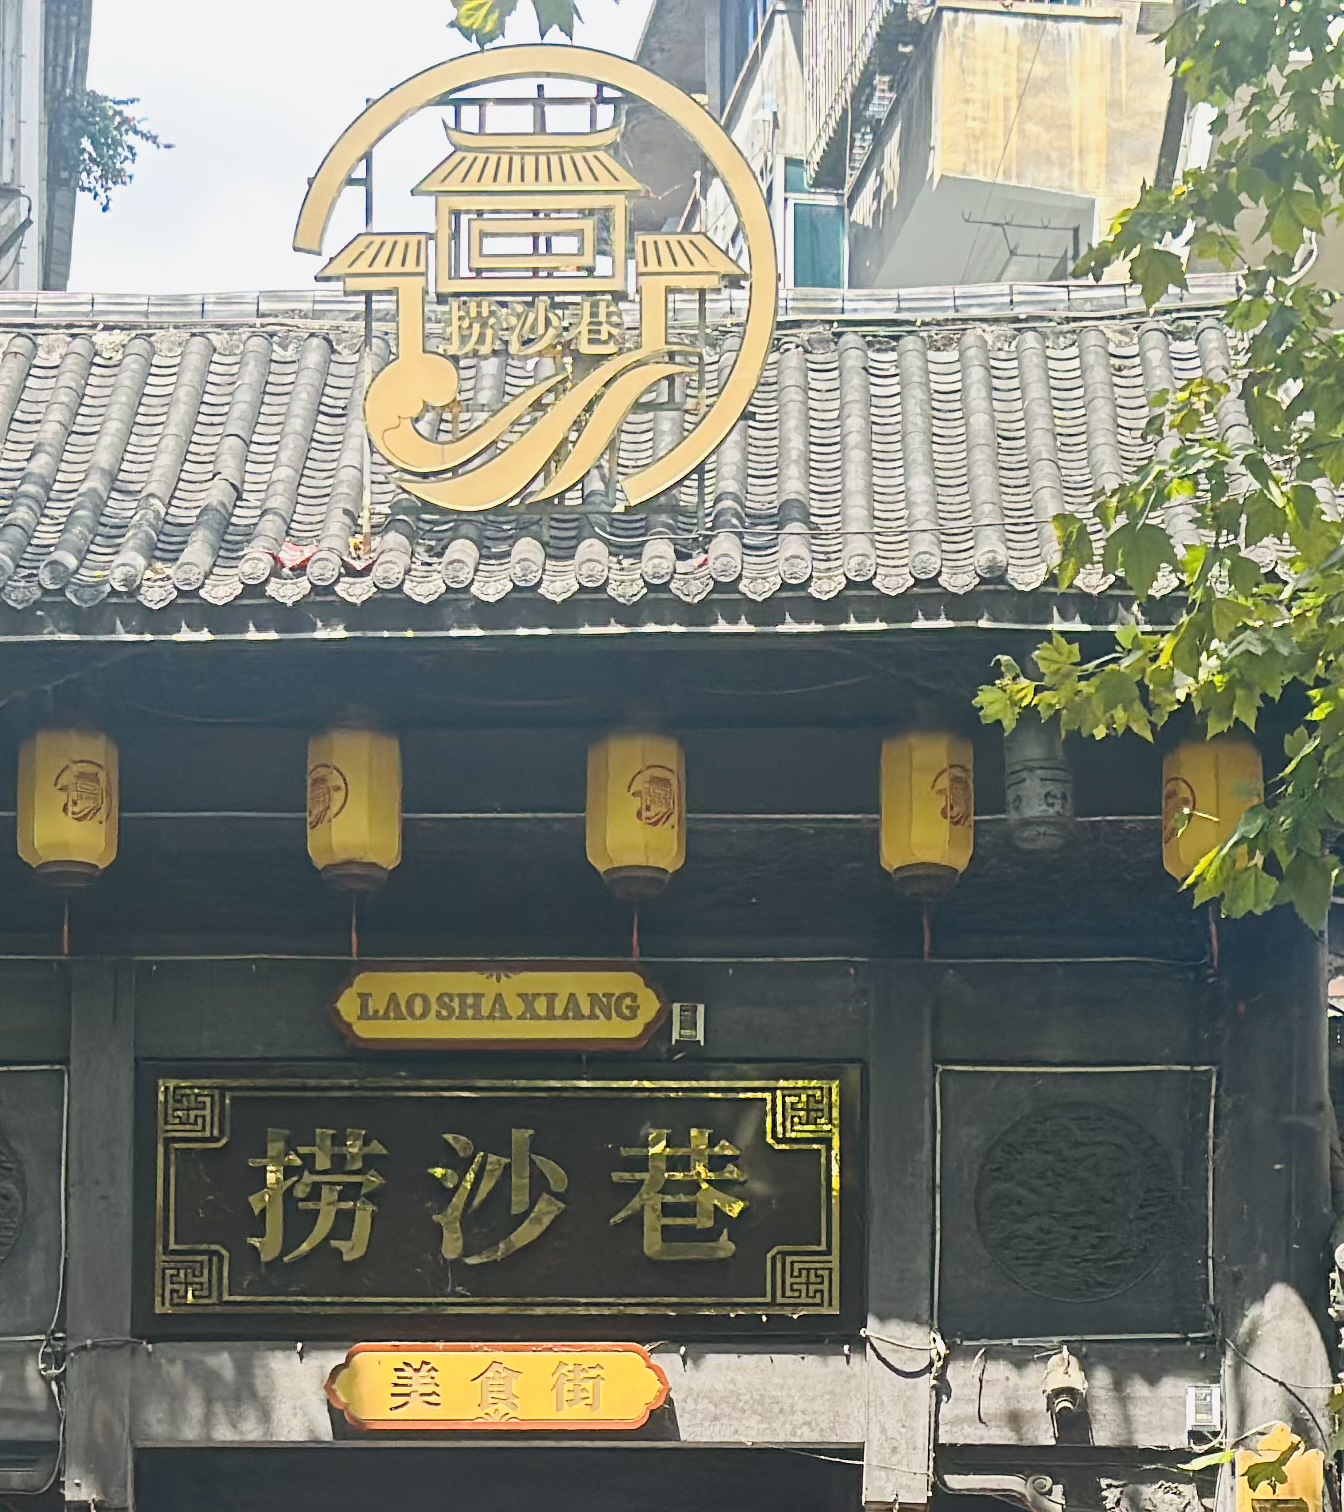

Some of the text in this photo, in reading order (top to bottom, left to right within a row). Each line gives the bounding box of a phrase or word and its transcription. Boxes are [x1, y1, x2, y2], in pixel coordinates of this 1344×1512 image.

[447, 299, 623, 356] 捞沙巷
[248, 1128, 748, 1265] 捞沙巷
[389, 1360, 606, 1413] 美食街
